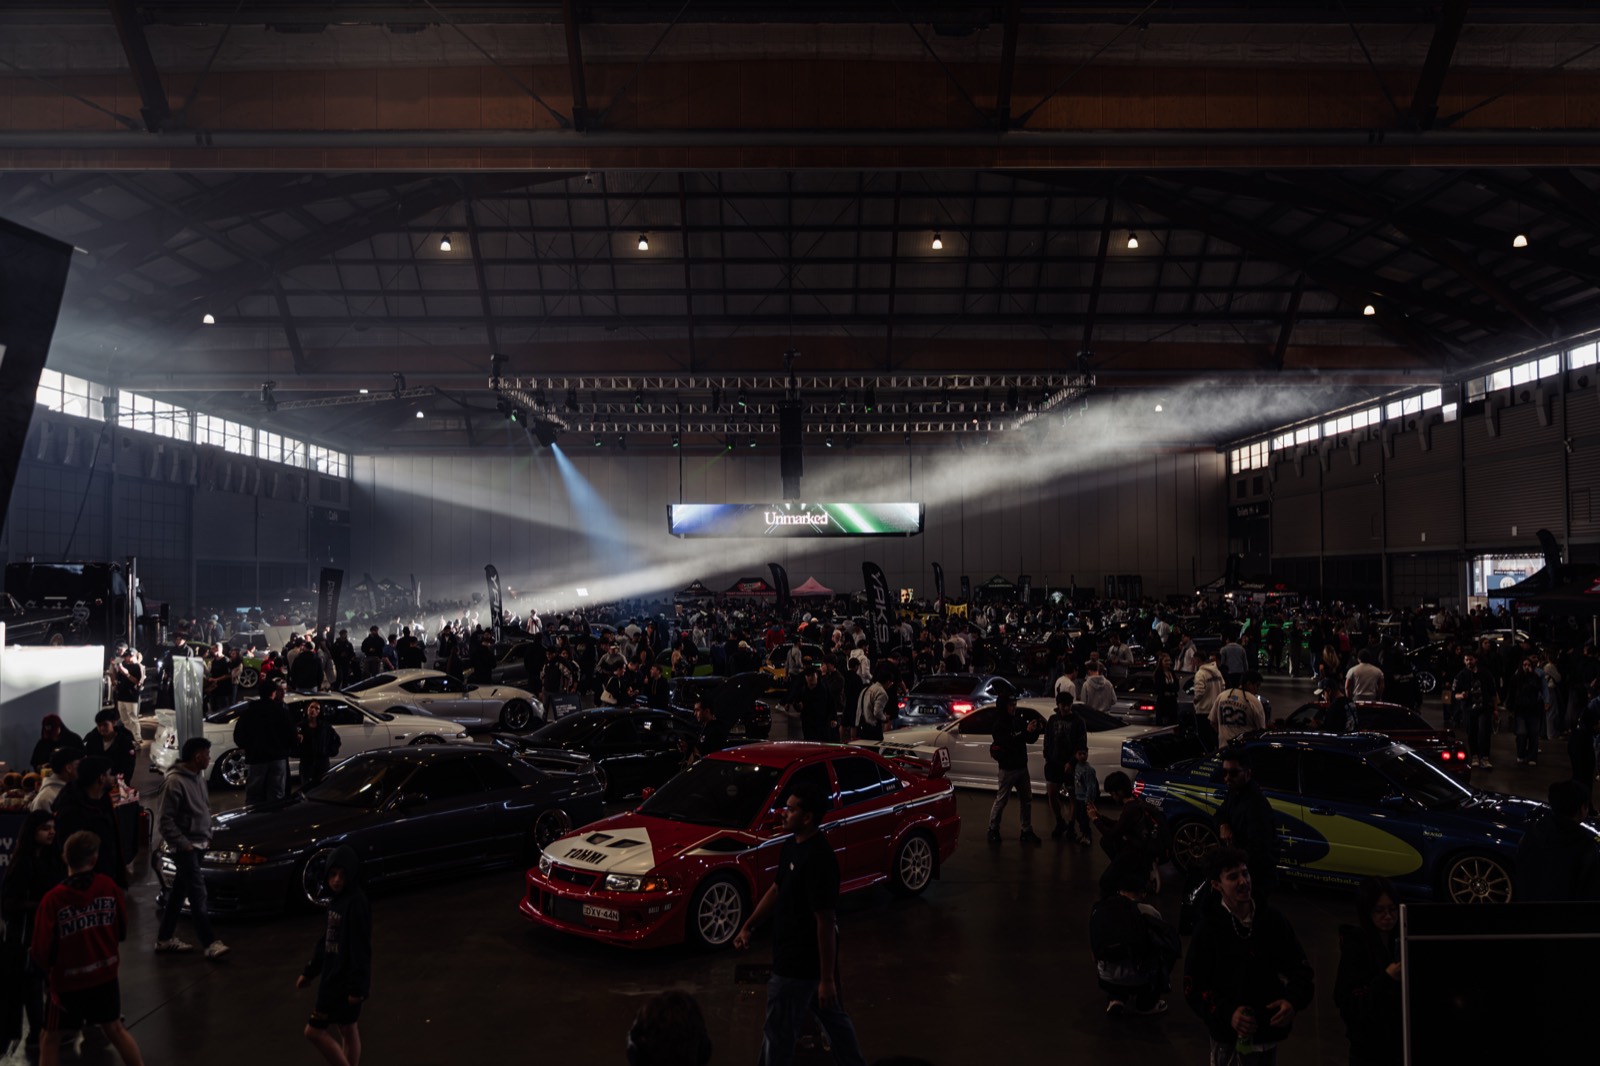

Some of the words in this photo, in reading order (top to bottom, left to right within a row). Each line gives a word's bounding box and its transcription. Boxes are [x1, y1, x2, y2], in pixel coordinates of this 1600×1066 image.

[764, 511, 829, 525] Unmarked
[871, 571, 889, 643] YAKS
[1220, 706, 1247, 725] 123
[563, 848, 608, 865] TOMMI
[61, 911, 115, 936] NORTH
